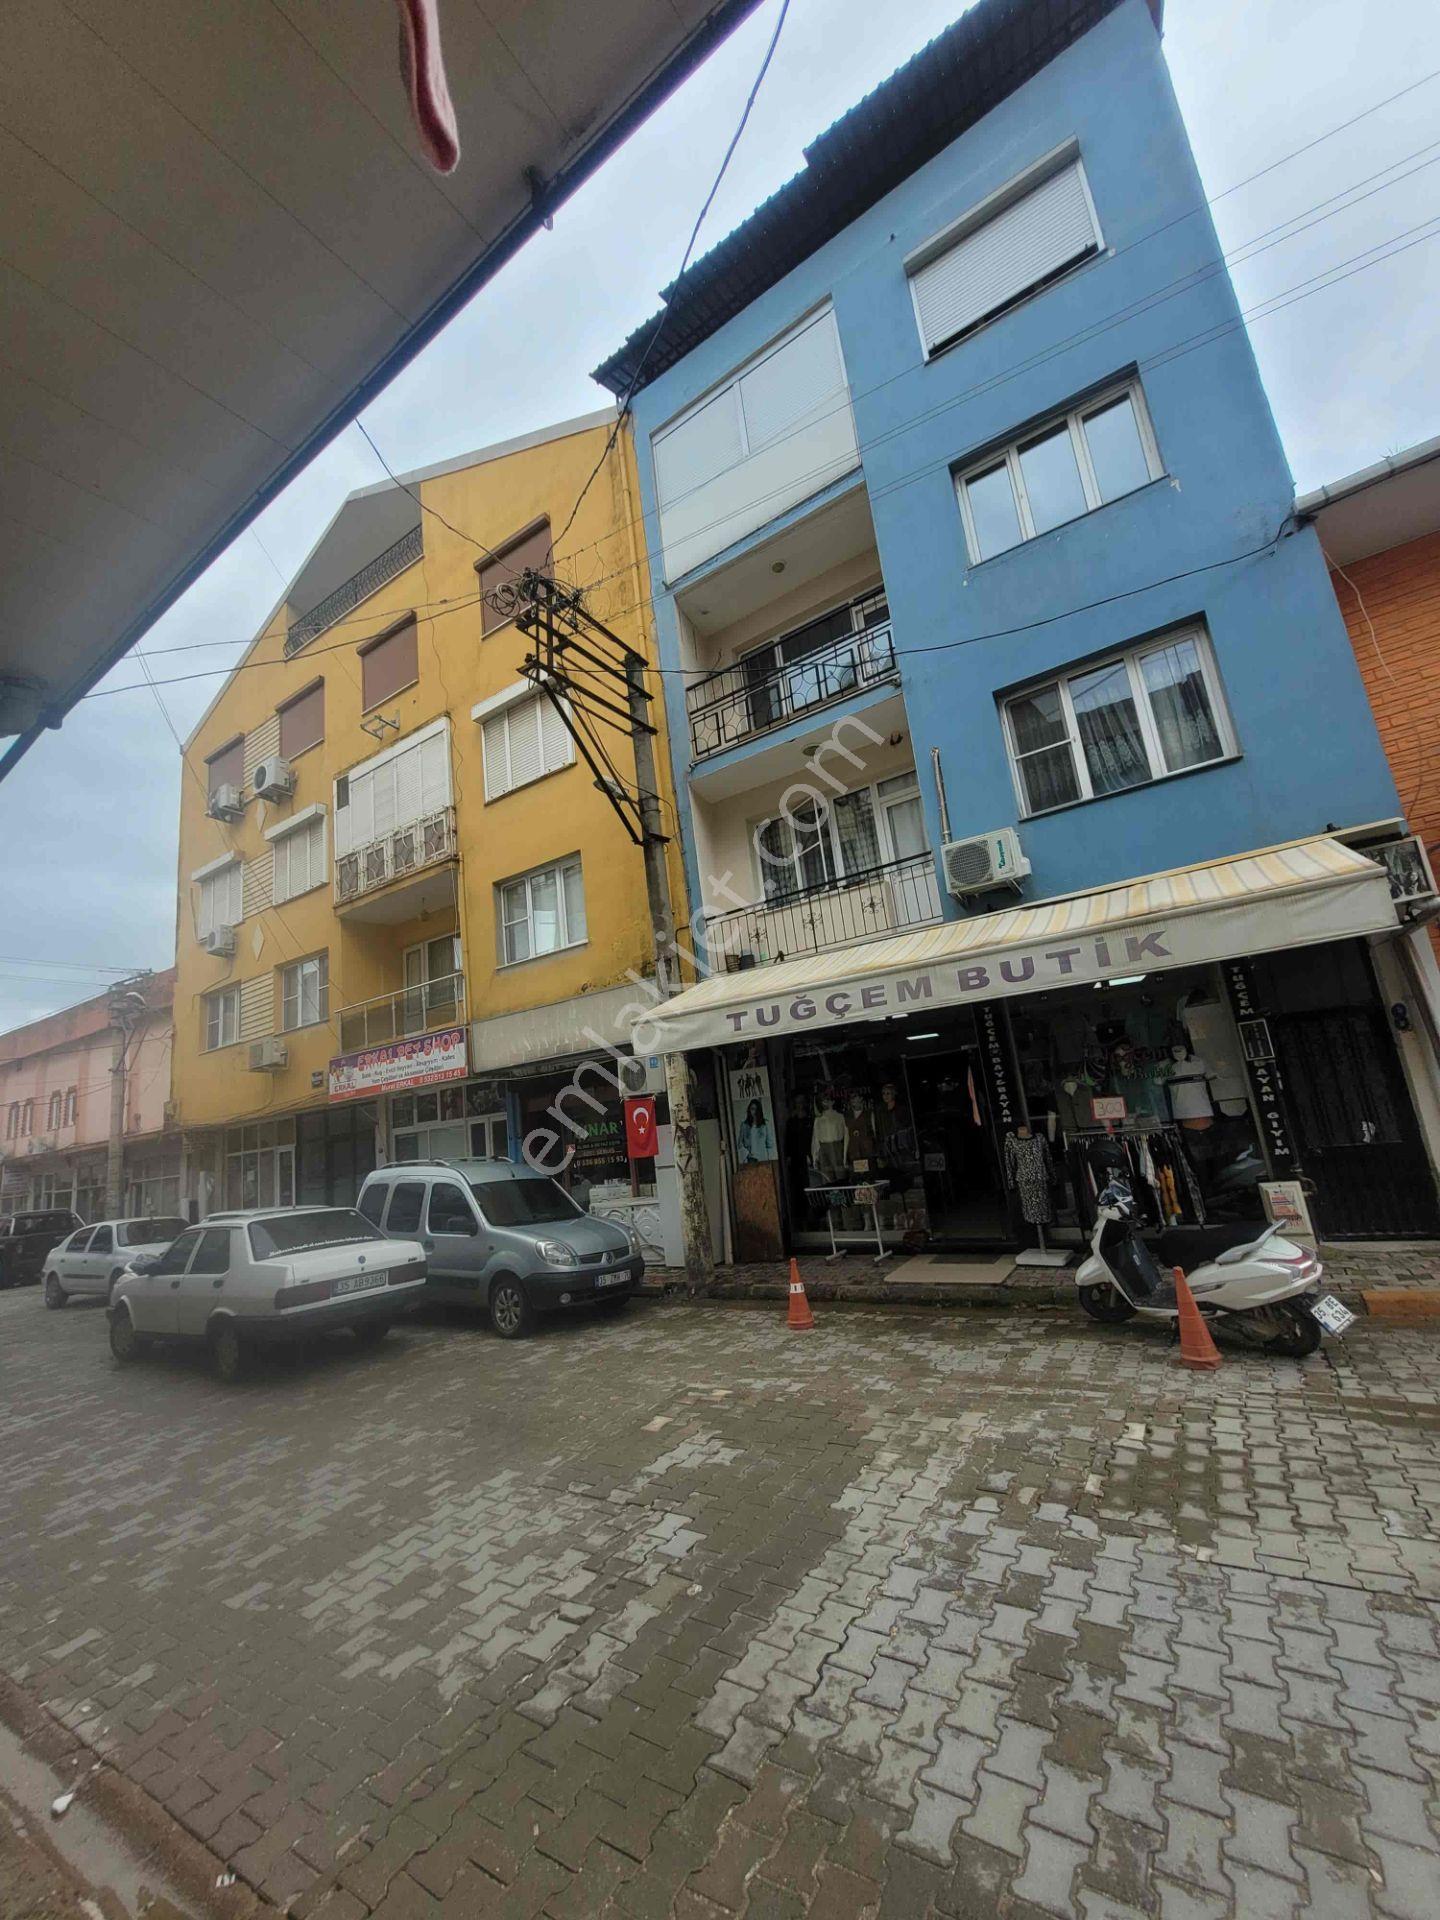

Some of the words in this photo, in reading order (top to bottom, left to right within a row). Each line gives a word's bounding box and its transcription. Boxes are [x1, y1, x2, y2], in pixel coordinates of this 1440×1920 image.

[726, 975, 934, 1032] TUĞÇEM
[957, 930, 1173, 993] BUTİK
[357, 1048, 395, 1072] ERKAL
[423, 1032, 461, 1056] SHOP
